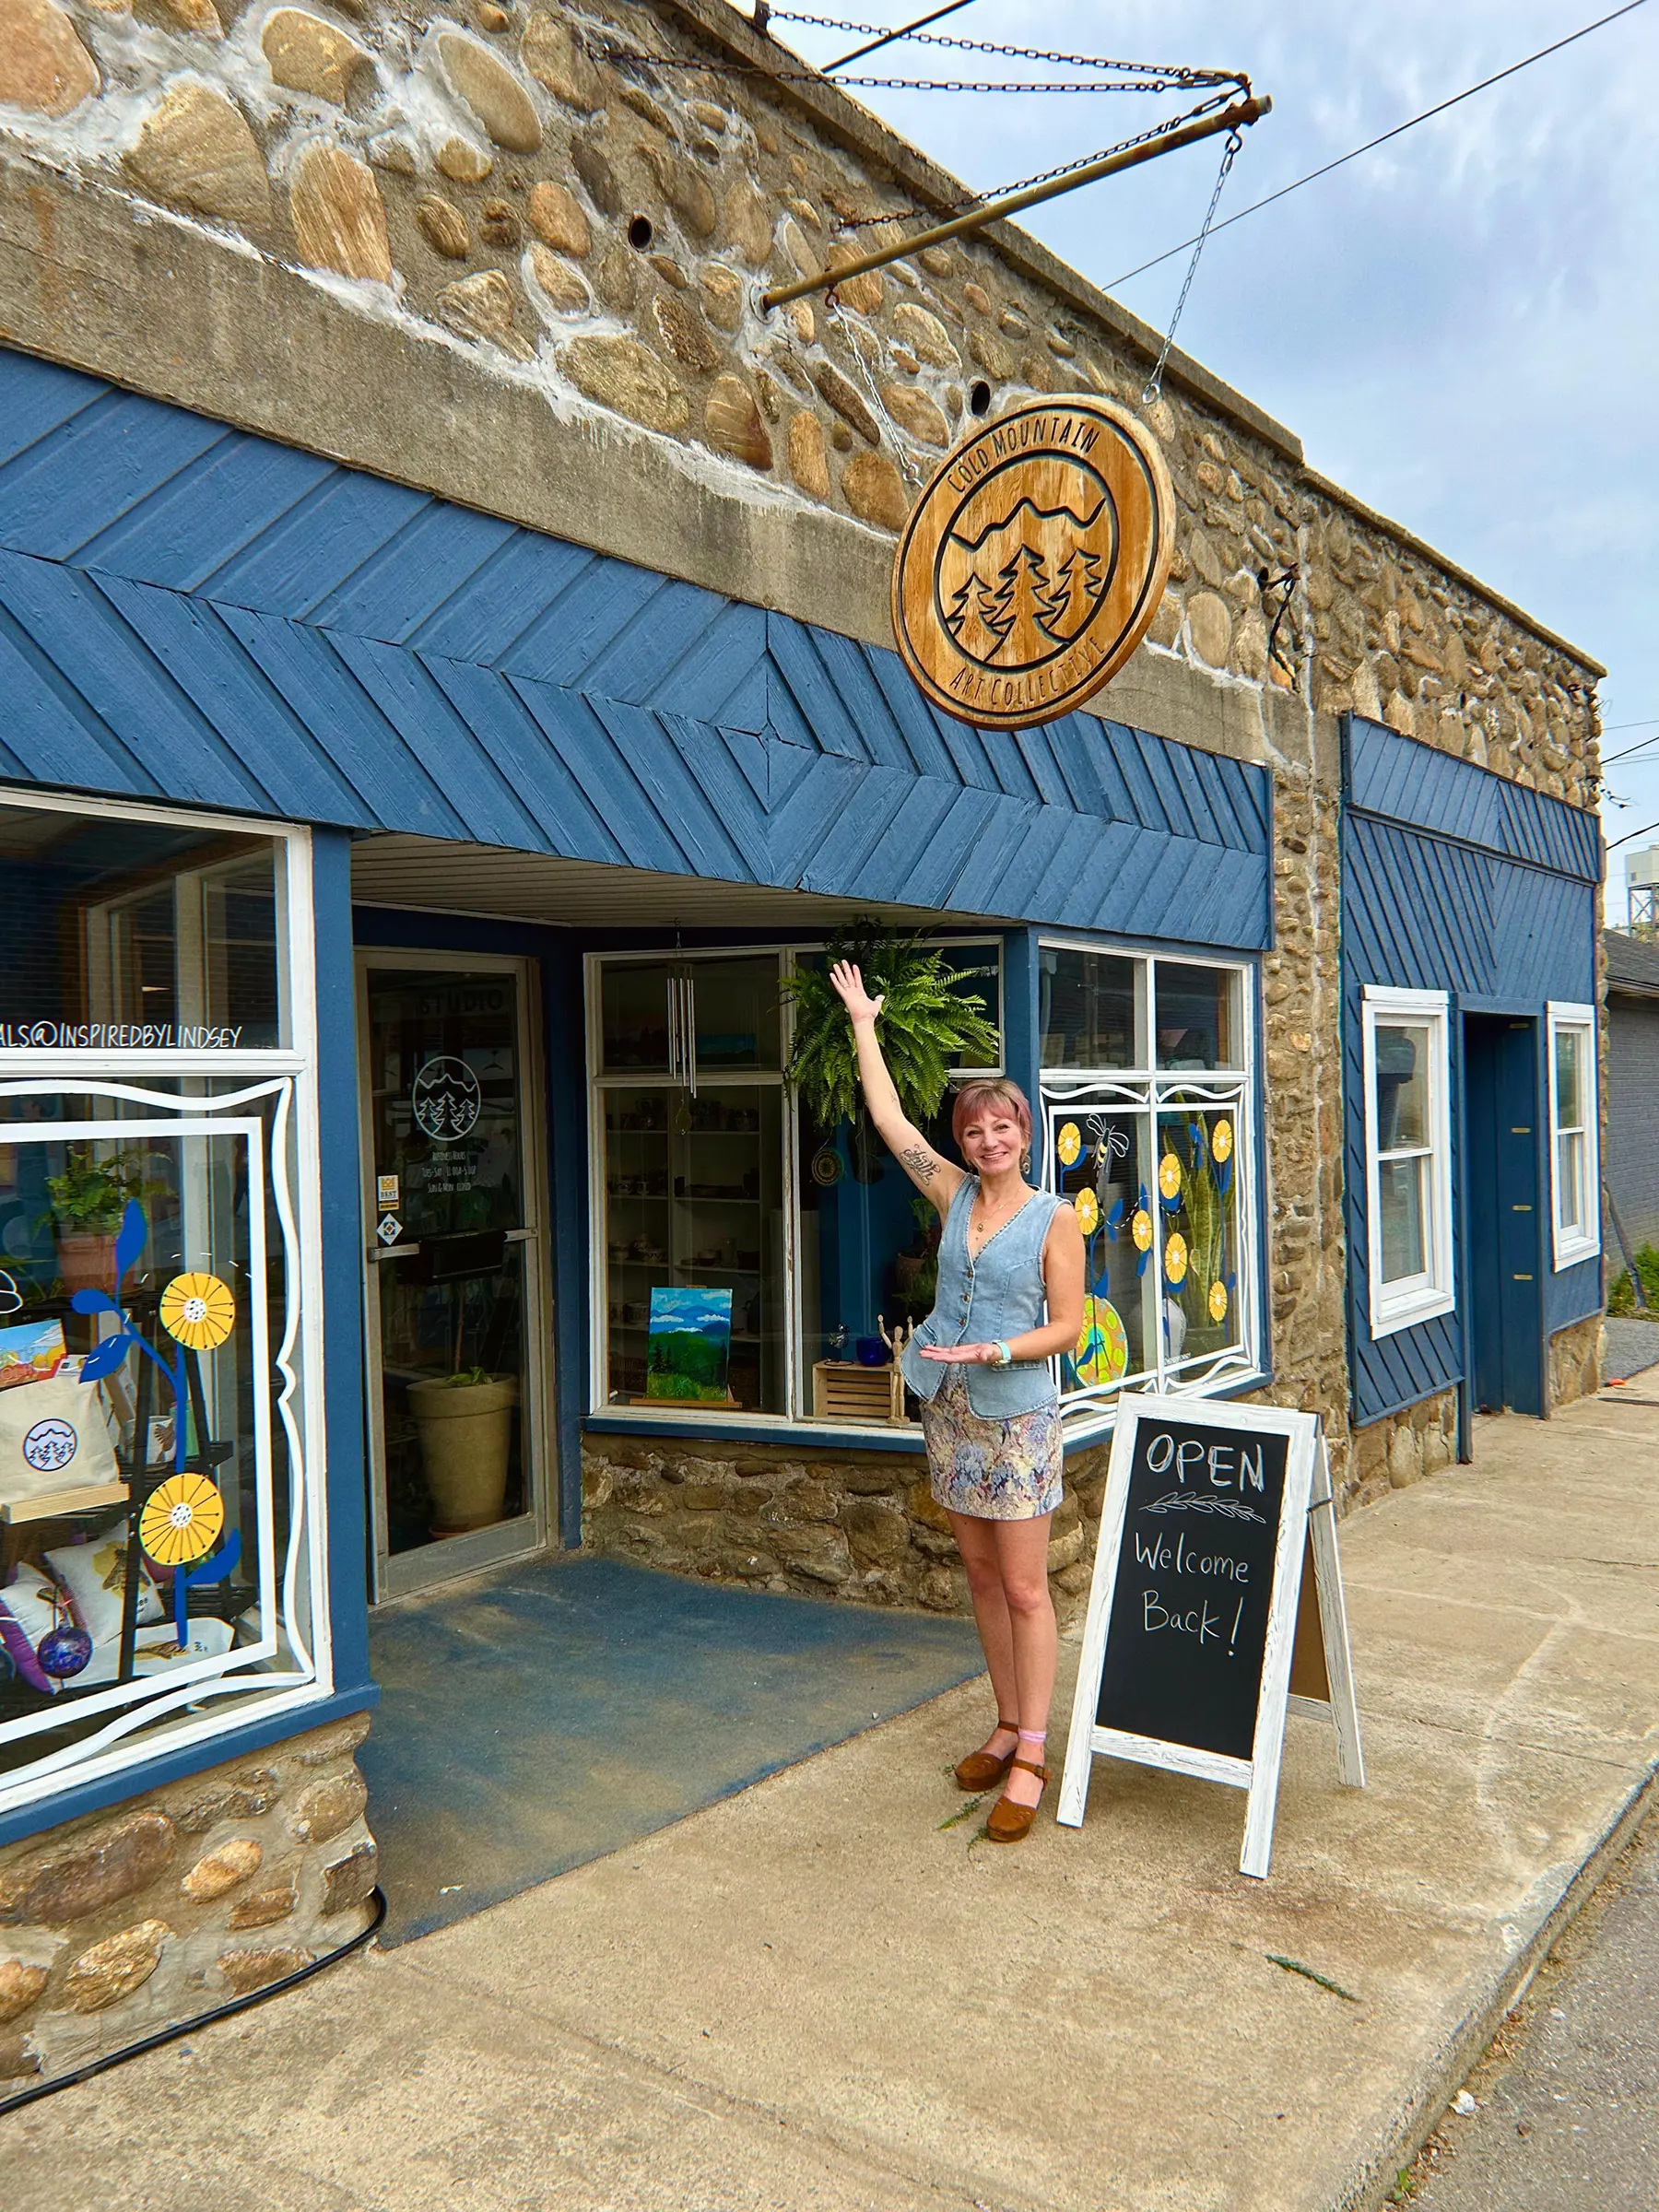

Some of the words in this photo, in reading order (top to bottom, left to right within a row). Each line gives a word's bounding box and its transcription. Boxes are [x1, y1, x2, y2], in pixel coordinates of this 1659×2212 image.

[947, 450, 988, 492] COLD
[993, 418, 1100, 458] MOUNTAIN
[949, 667, 982, 700] ART
[990, 636, 1104, 706] COLLECTIVE
[1146, 1434, 1265, 1492] OPEN
[1135, 1532, 1249, 1583] Welcome
